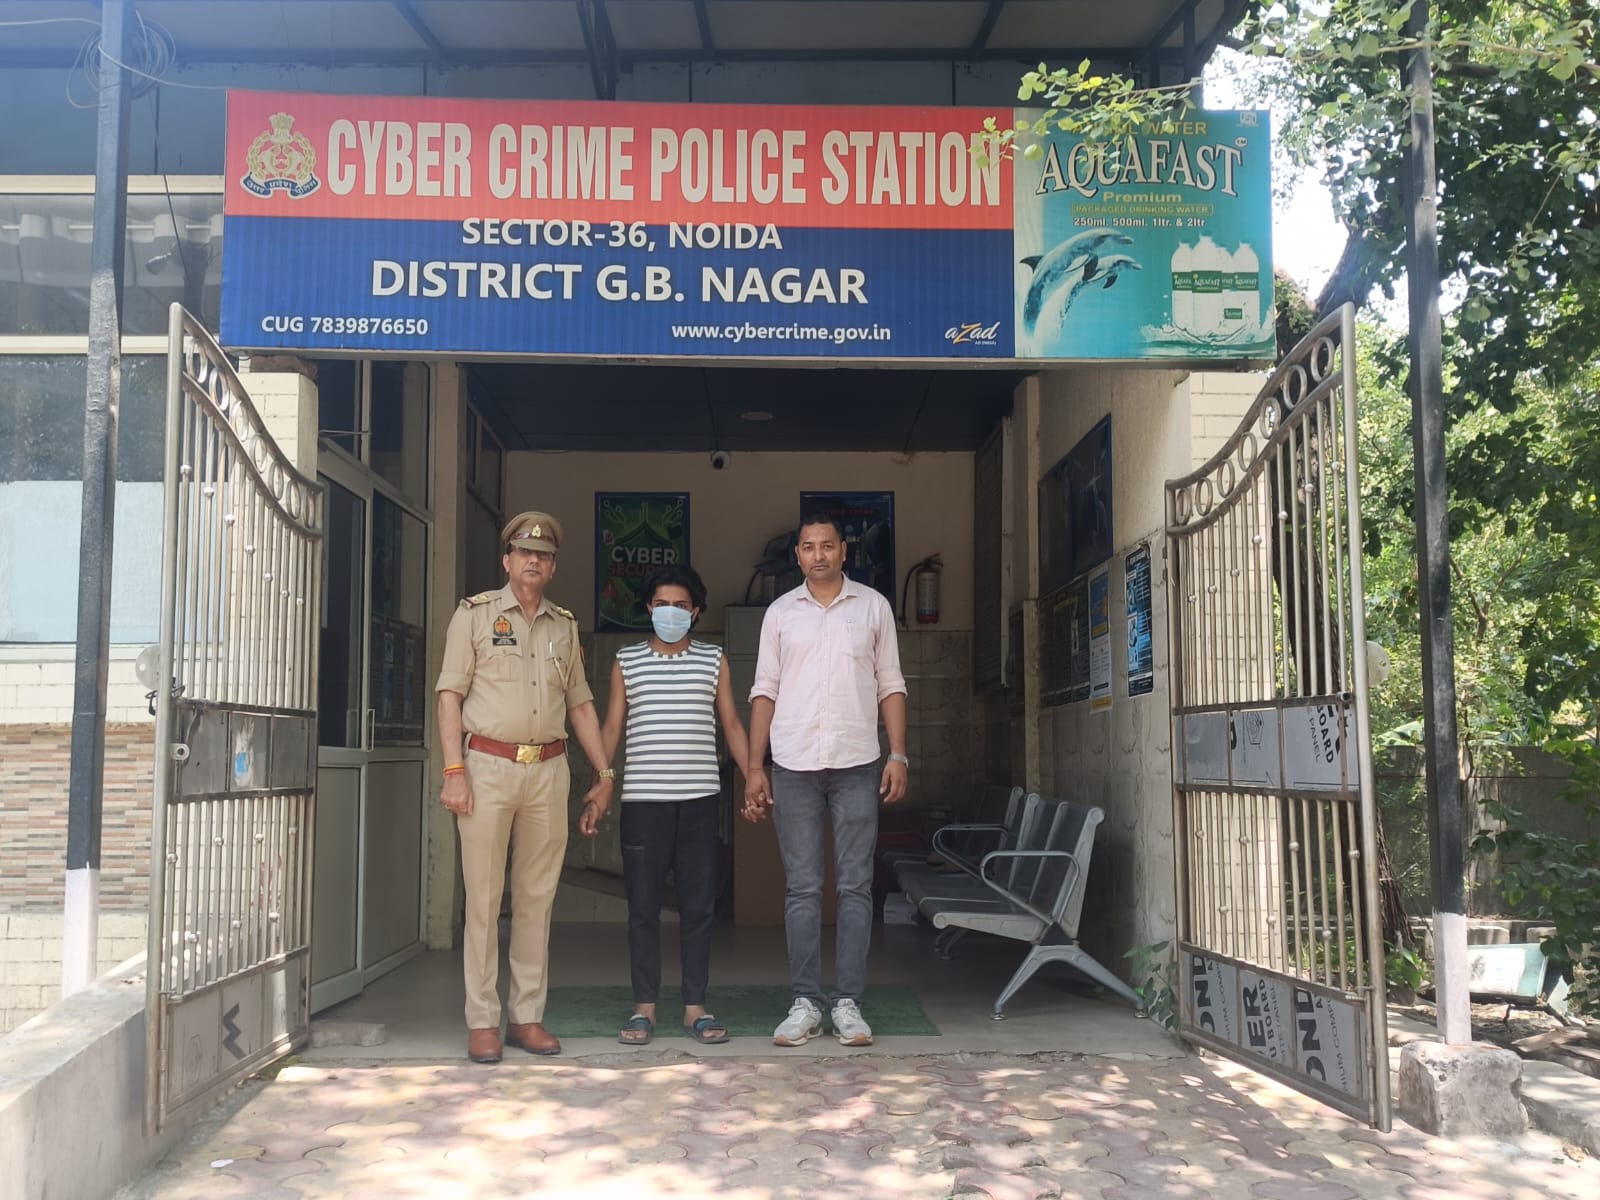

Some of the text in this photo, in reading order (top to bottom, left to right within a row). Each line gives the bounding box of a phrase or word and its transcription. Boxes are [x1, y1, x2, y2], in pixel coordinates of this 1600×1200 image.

[327, 119, 1001, 206] CYBER CRIME POLICE STATION
[1035, 138, 1242, 198] AQUAFAST
[1103, 191, 1182, 203] Premium
[1130, 206, 1174, 214] DRINKING
[1177, 206, 1208, 214] WATER
[1175, 217, 1184, 227] &
[462, 217, 783, 252] SECTOR-36, NOIDA
[372, 260, 869, 304] DISTRICT G.B. NAGAR
[261, 315, 429, 336] CUG 7839876650
[671, 321, 891, 344] www.cybercrime.gov.in
[611, 545, 676, 565] CYBER
[1258, 979, 1275, 1040] BOARD
